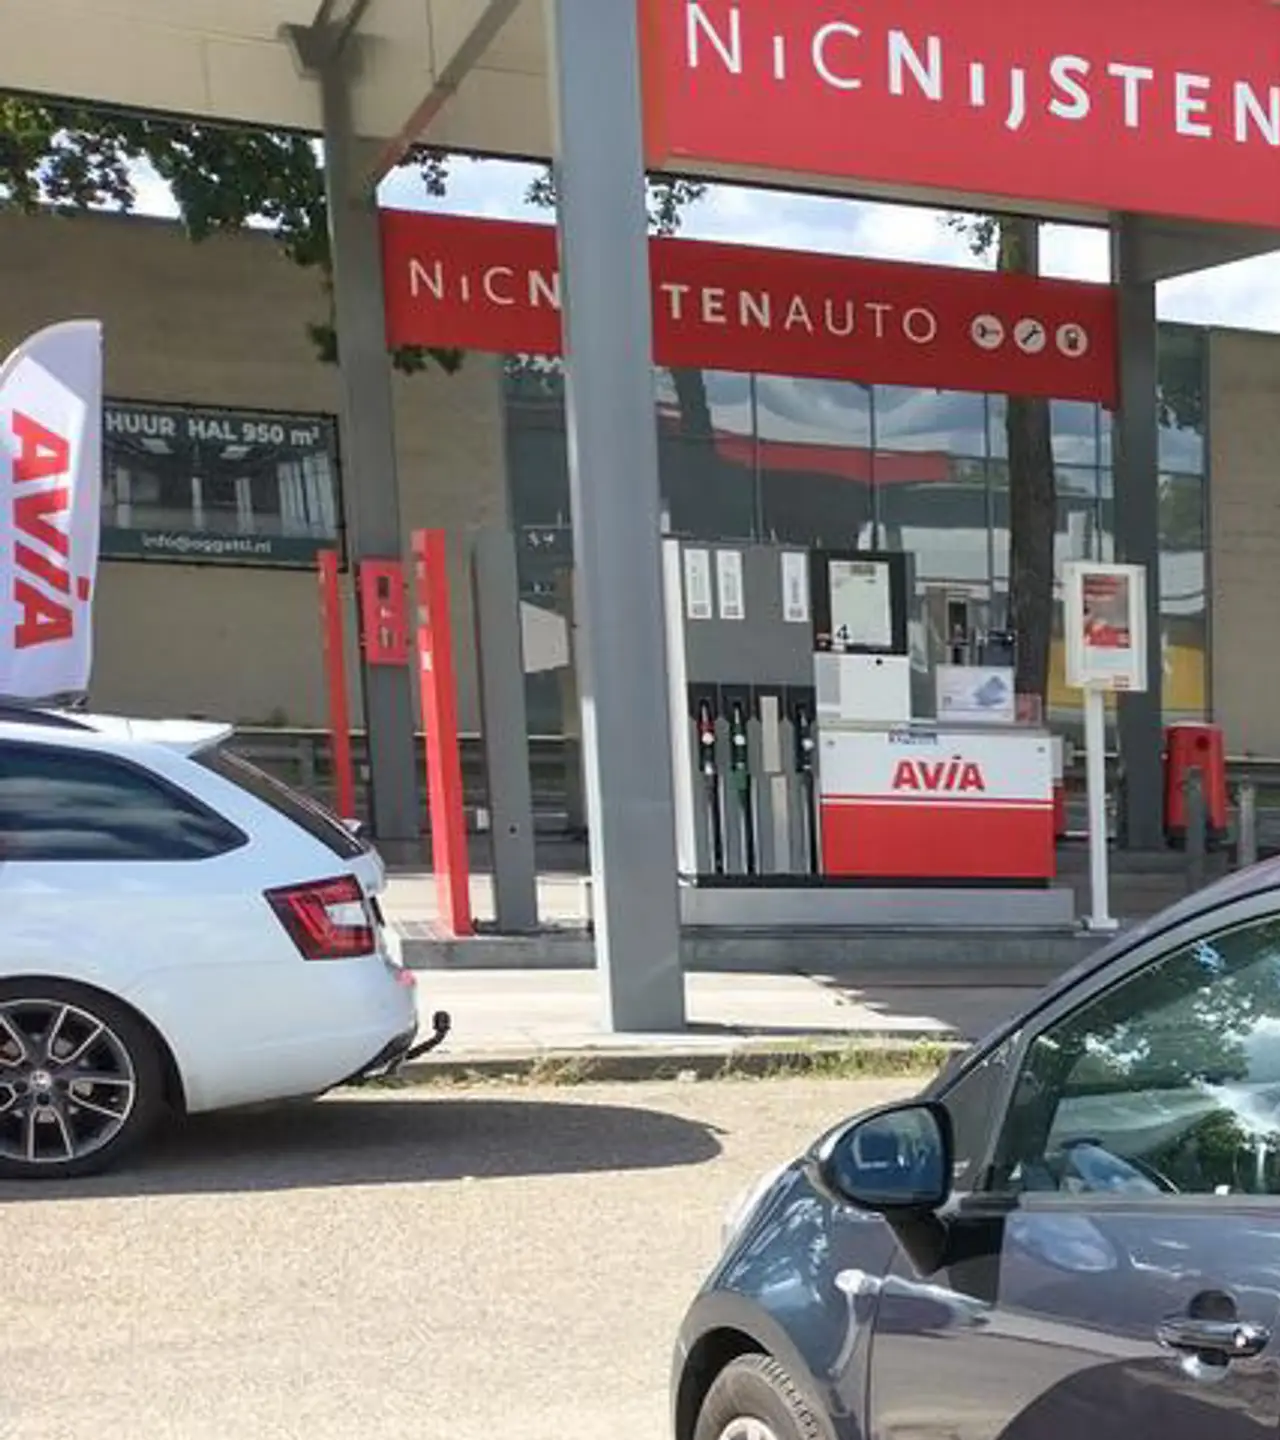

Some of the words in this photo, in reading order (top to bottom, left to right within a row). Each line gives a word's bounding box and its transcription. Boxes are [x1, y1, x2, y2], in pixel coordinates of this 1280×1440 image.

[105, 413, 176, 437] HUUR
[188, 419, 237, 441] HAL
[242, 424, 284, 445] 950
[12, 408, 90, 649] AVIA
[893, 754, 985, 792] AVIA
